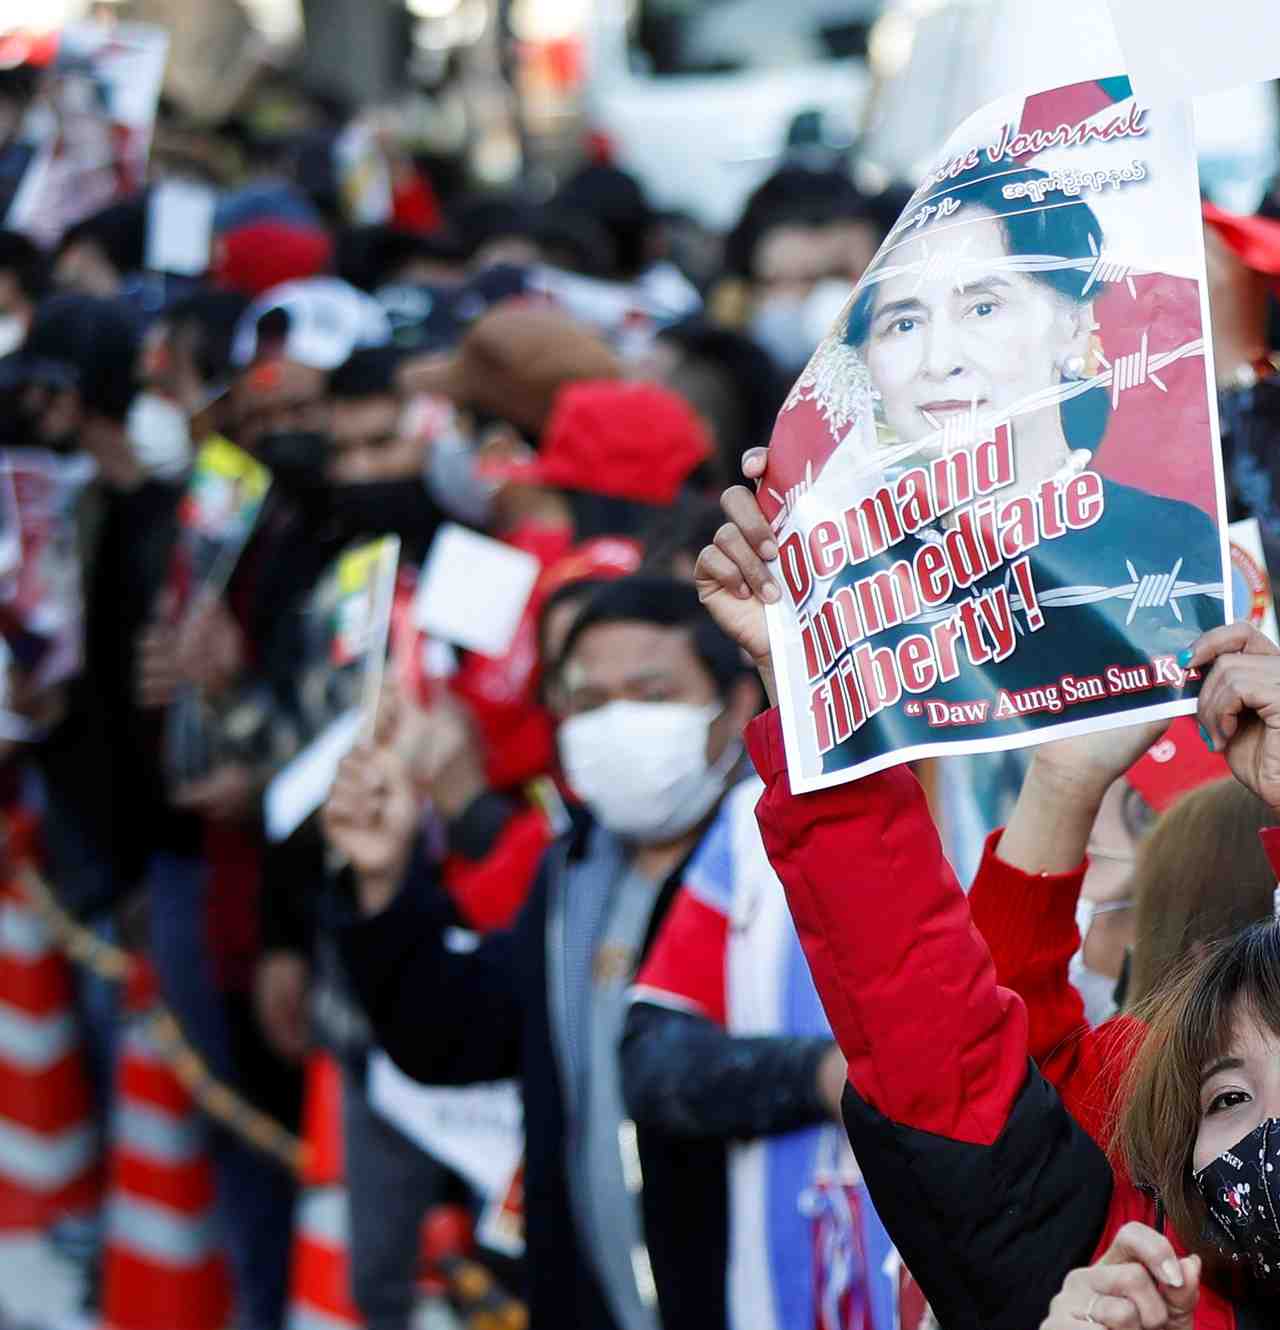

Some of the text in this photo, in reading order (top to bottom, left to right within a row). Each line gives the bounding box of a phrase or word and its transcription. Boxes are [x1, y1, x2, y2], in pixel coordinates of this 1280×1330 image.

[986, 102, 1148, 163] Journal
[778, 418, 1015, 610] Demand
[799, 471, 1105, 683] immediate
[928, 701, 988, 726] Daw
[995, 687, 1062, 716] Aung
[1062, 676, 1105, 703] San
[1109, 667, 1150, 694] Suu
